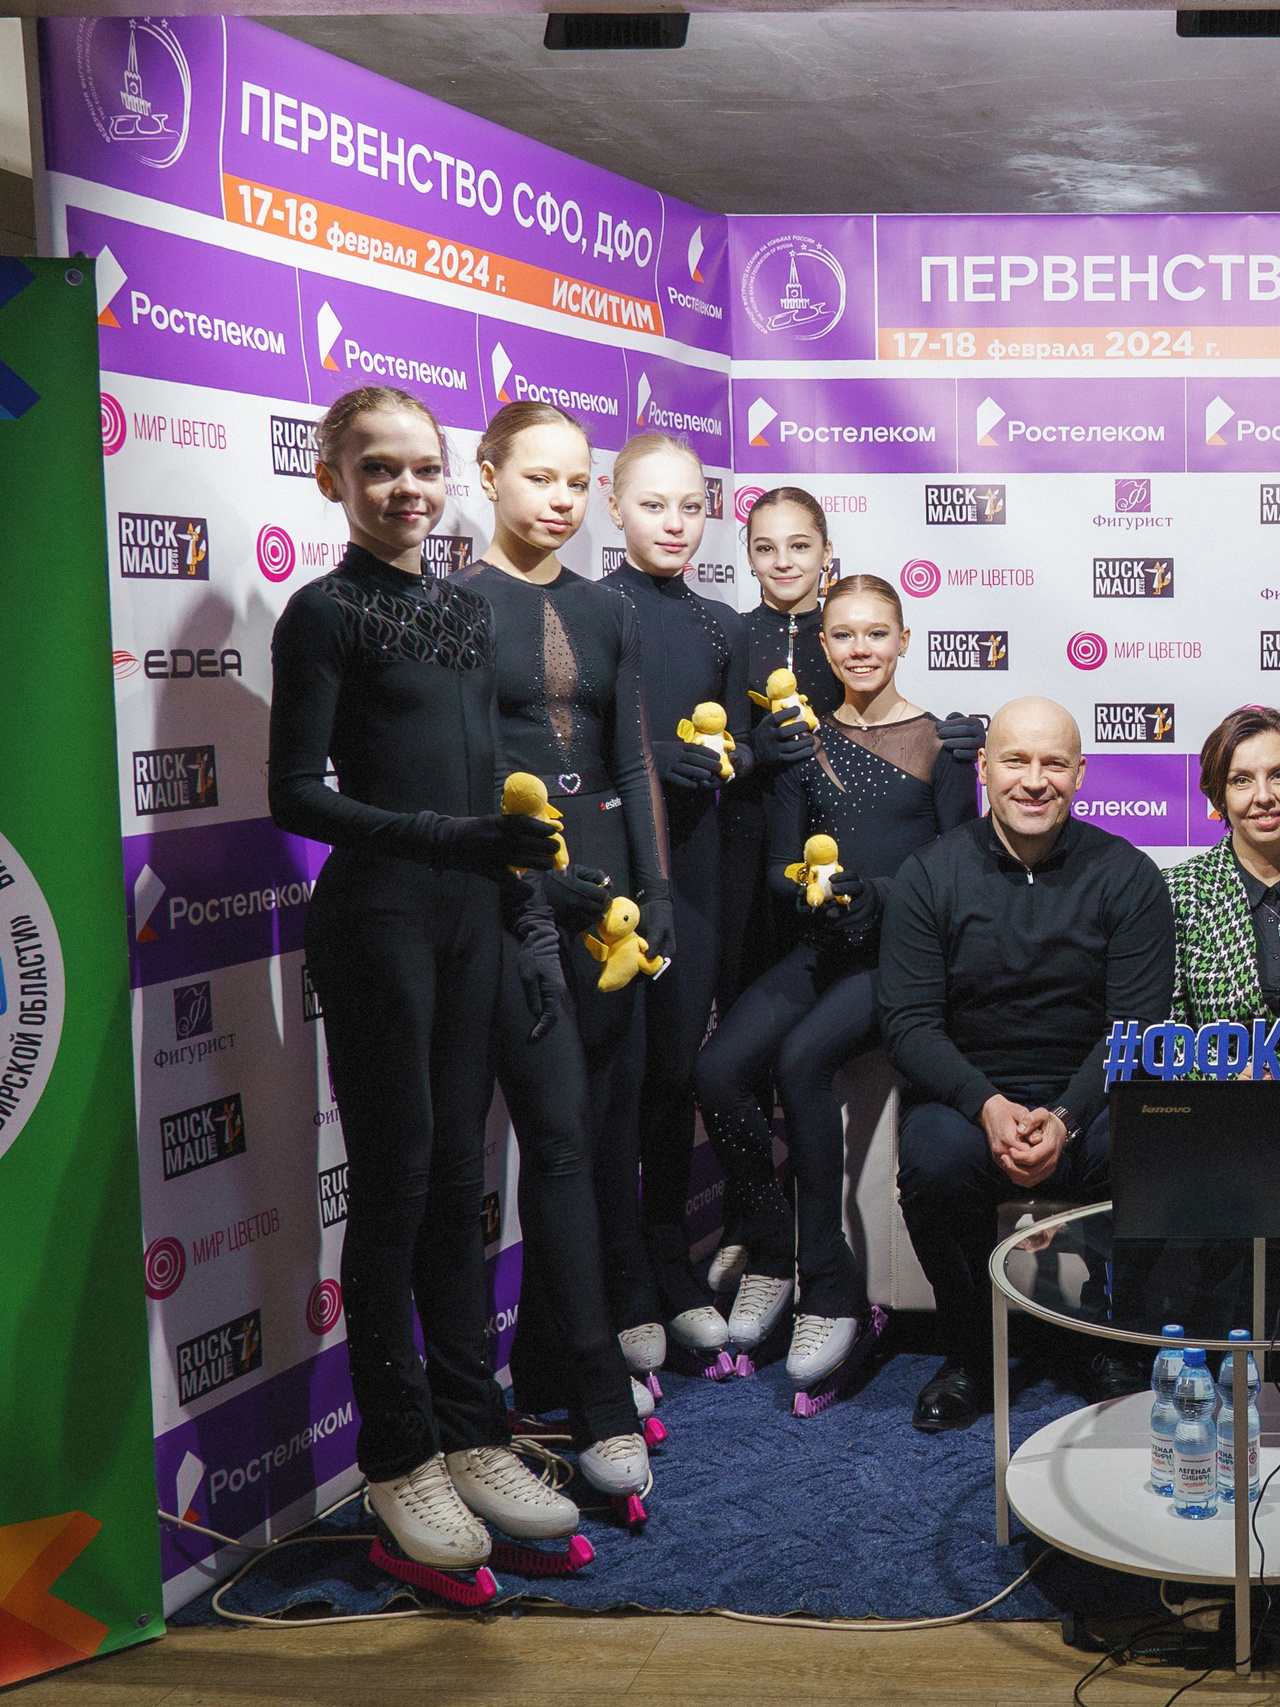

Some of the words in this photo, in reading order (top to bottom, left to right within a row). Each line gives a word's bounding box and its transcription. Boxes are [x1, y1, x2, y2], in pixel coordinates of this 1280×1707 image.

[240, 80, 503, 217] ПЕРВЕНСТВО
[512, 181, 588, 255] СФО,
[592, 213, 653, 268] ДФО
[237, 183, 319, 241] 17-18
[326, 220, 417, 268] февраля
[423, 239, 490, 288] 2024
[495, 273, 506, 293] г.
[552, 276, 655, 332] ИСКИТИМ
[667, 285, 723, 321] Ростелеком
[130, 290, 287, 356] Ростелеком
[892, 332, 977, 358] 17-18
[986, 339, 1095, 361] февраля
[1105, 331, 1194, 358] 2024
[1206, 341, 1221, 357] г.
[344, 338, 468, 391] Ростелеком
[514, 373, 619, 416] Ростелеком
[133, 412, 167, 442] МИР
[170, 416, 227, 450] ЦВЕТОВ
[648, 400, 723, 437] Ростелеком
[779, 421, 936, 443] Ростелеком
[1007, 421, 1165, 443] Ростелеком
[271, 420, 320, 450] RUCK
[927, 488, 977, 505] RUCK
[927, 504, 977, 522] MAUL
[1092, 514, 1173, 531] Фигурист
[120, 517, 178, 547] RUCK
[122, 546, 179, 574] MAUL
[301, 542, 328, 567] МИР
[1094, 561, 1145, 577] RUCK
[697, 563, 735, 584] EDEA
[947, 568, 978, 586] МИР
[980, 568, 1035, 588] ЦВЕТОВ
[1094, 577, 1145, 595] MAUL
[929, 633, 980, 651] RUCK
[1113, 641, 1145, 659] МИР
[1148, 641, 1202, 660] ЦВЕТОВ
[144, 648, 242, 679] EDEA
[929, 650, 980, 668] MAUL
[1096, 706, 1146, 724] RUCK
[1096, 723, 1146, 741] MAUL
[135, 753, 188, 784] RUCK
[136, 780, 190, 811] MAUL
[1073, 800, 1168, 817] елеком
[10, 914, 48, 1027] ОБЛАСТИ»
[153, 1033, 237, 1068] Фигурист
[1141, 1104, 1192, 1115] lenovo
[162, 1107, 215, 1148] RUCK
[192, 1230, 224, 1266] МИР
[226, 1207, 280, 1253] ЦВЕТОВ
[179, 1327, 233, 1375] RUCK
[209, 1401, 353, 1505] Ростелеком
[1178, 1467, 1211, 1475] ЛЕГЕНДА
[1181, 1473, 1210, 1481] СИБИРИ
